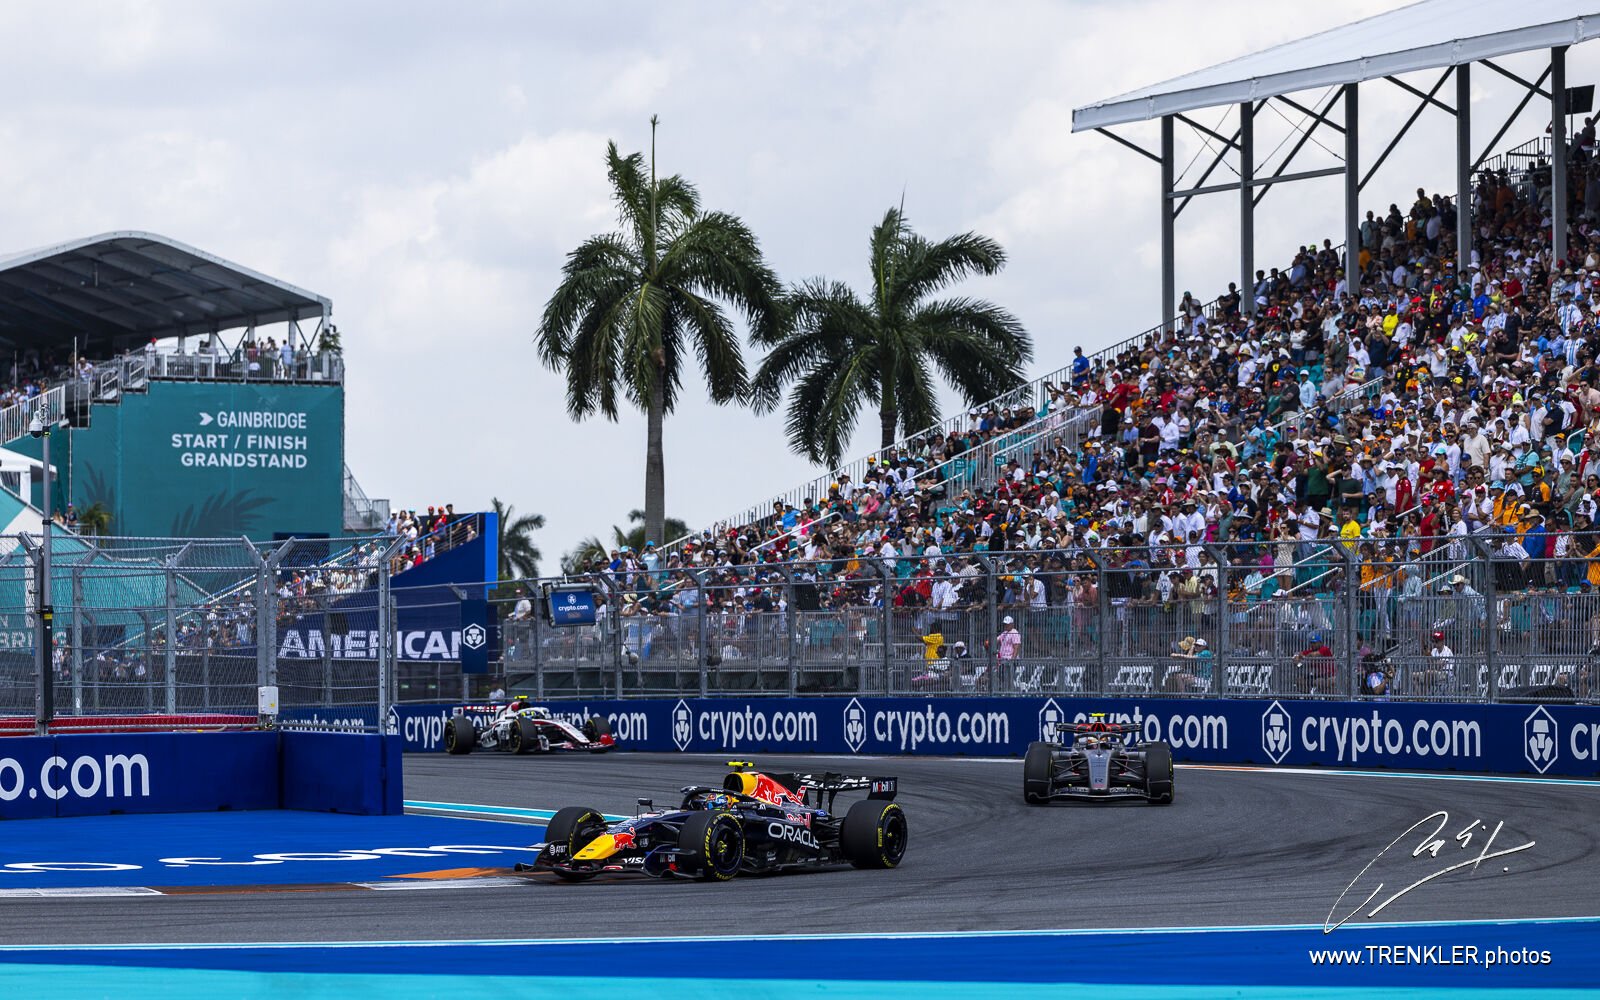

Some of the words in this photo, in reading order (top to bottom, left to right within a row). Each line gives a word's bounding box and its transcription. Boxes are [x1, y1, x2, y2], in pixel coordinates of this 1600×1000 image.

[217, 411, 307, 429] GAINBRIDGE
[171, 433, 228, 449] START
[234, 434, 241, 449] /
[247, 434, 307, 450] FINISH
[181, 452, 307, 469] GRANDSTAND
[558, 604, 589, 612] crypto.com
[699, 705, 817, 748] crypto.com
[873, 704, 1009, 750] crypto.com
[1301, 710, 1481, 762] crypto.com
[0, 753, 150, 801] o.com
[768, 822, 820, 850] ORACLE
